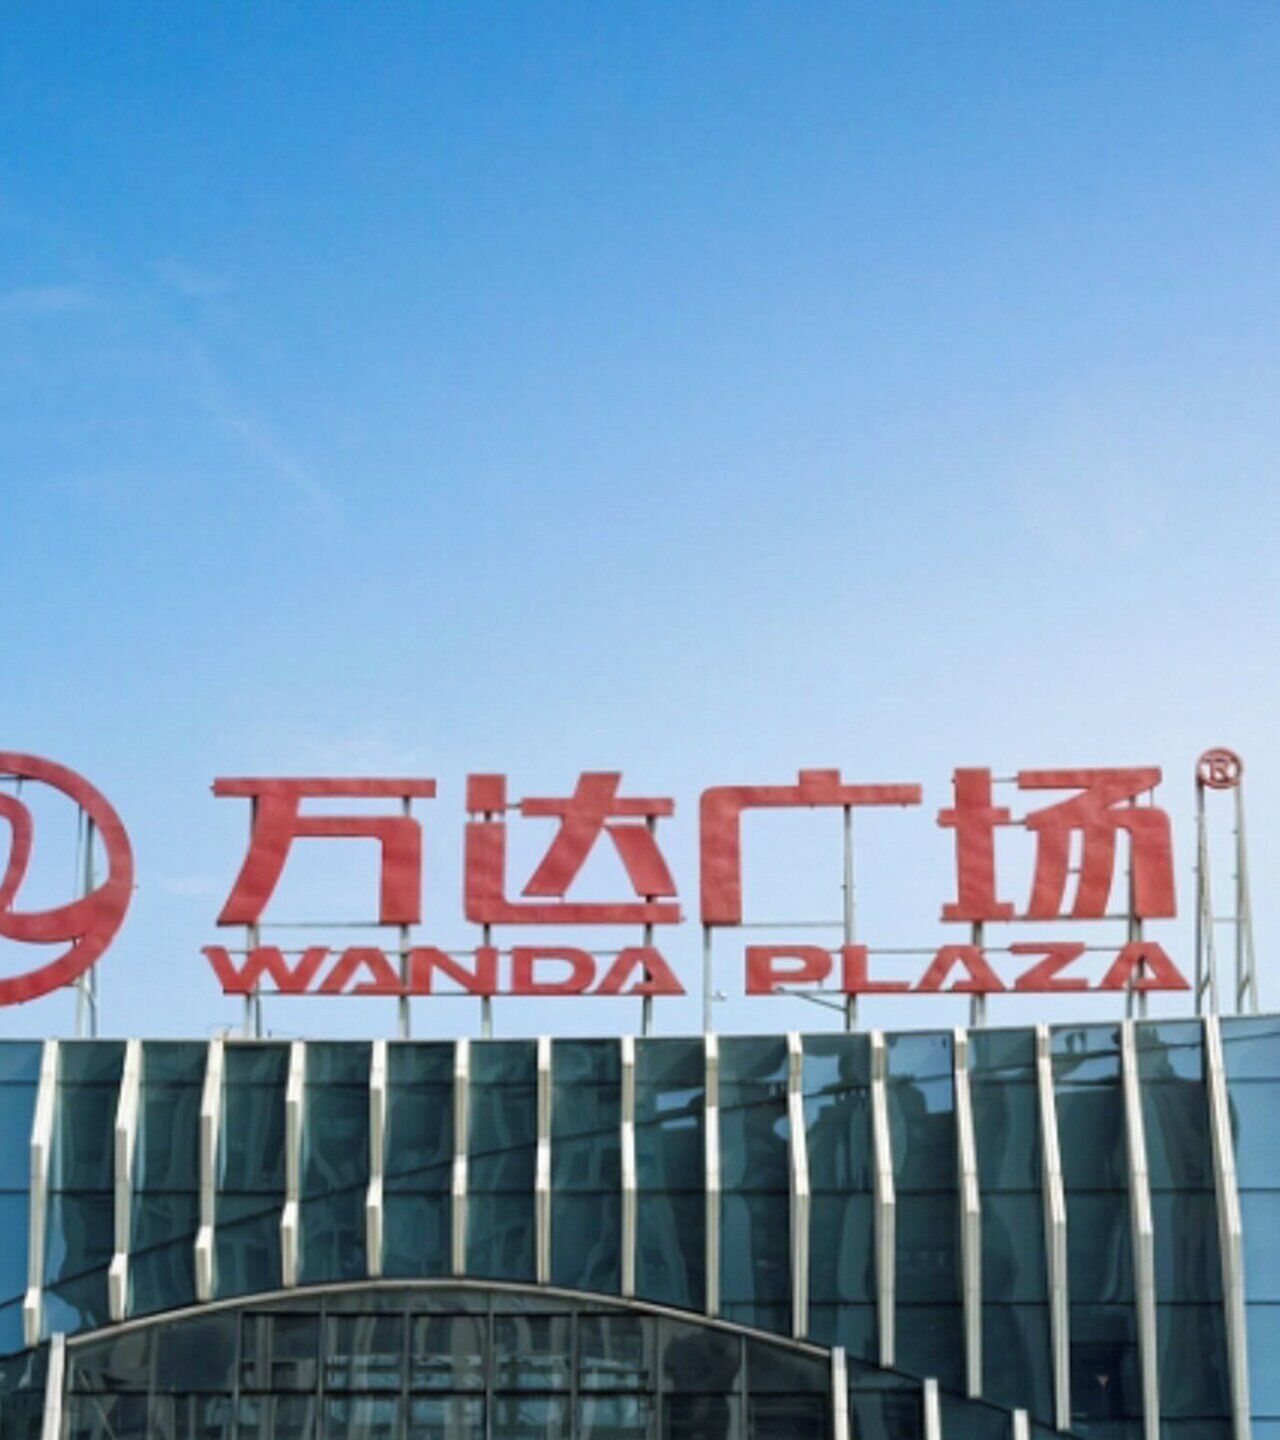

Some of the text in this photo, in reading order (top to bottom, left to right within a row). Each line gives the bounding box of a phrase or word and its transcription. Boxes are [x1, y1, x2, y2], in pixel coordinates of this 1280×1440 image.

[213, 767, 1177, 926] 万达广场
[201, 941, 1192, 996] WANDA PLAZA
